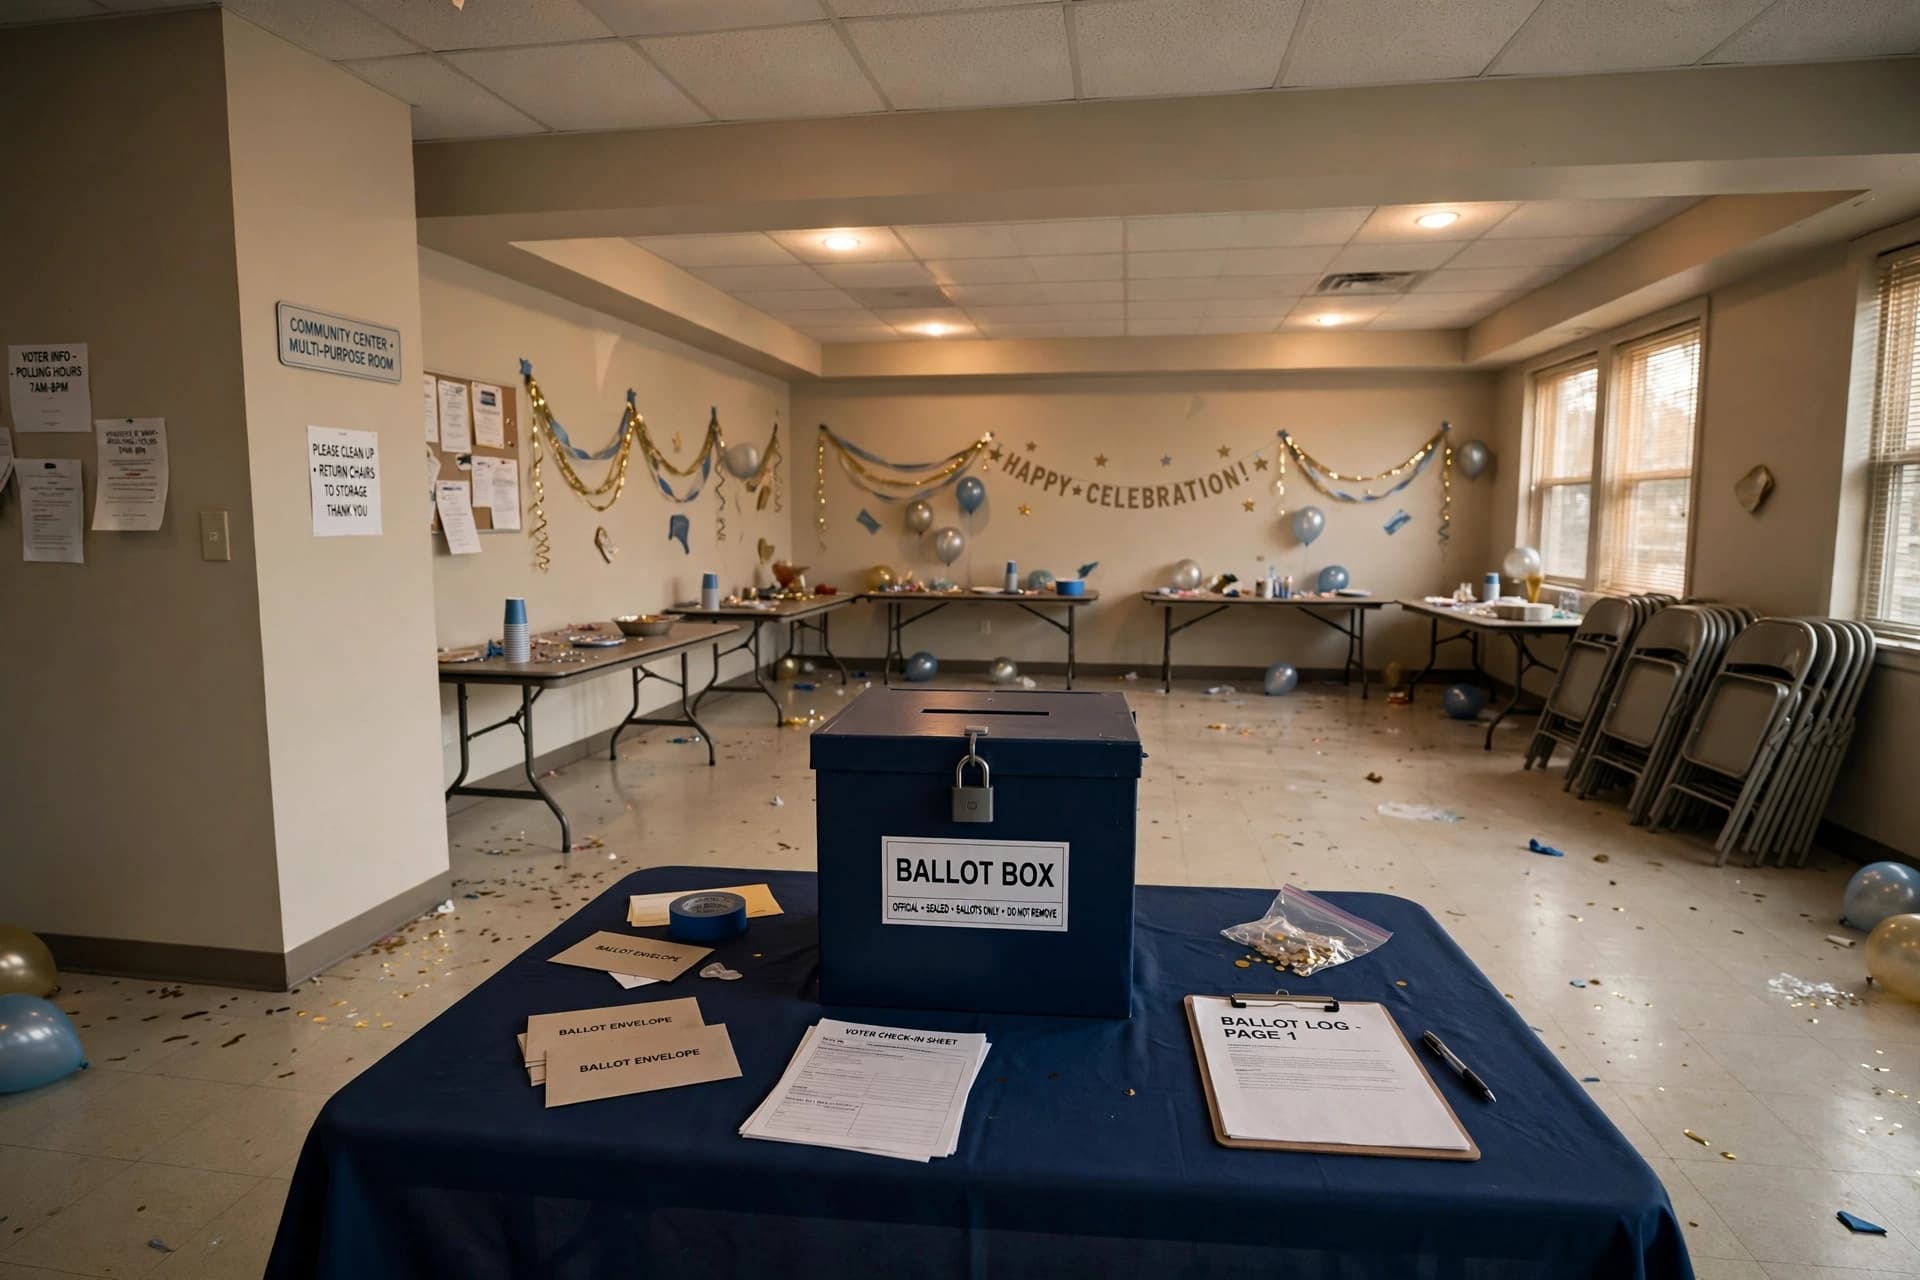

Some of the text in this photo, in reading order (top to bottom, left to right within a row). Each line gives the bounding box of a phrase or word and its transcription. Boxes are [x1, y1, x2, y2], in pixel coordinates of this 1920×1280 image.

[290, 317, 387, 351] COMMUNITY CENTER
[22, 351, 49, 363] VOTER
[51, 351, 71, 362] INFO
[289, 337, 394, 371] MULTI-PURPOSE ROOM
[16, 366, 82, 378] POLLING HOURS
[312, 442, 375, 459] PLEASE CLEAN UP
[319, 464, 376, 479] RETURN CHAIRS
[1002, 452, 1250, 509] HAPPY CELEBRATION!
[324, 484, 367, 498] TO STORAGE
[327, 504, 368, 518] THANK YOU
[896, 857, 1055, 888] BALLOT BOX
[892, 902, 1057, 919] OFFICIAL SEALED BALLOTS ONLY DO NOT REMOVE
[595, 944, 682, 962] BALLOT ENVELOPE
[559, 1016, 673, 1036] BALLOT ENVELOPE
[1220, 1015, 1299, 1030] BALLOT
[1305, 1019, 1350, 1031] LOG
[845, 1027, 959, 1046] VOTER CHECK-IN SHEET
[1224, 1029, 1298, 1041] PAGE 1
[579, 1048, 701, 1073] BALLOT ENVELOPE
